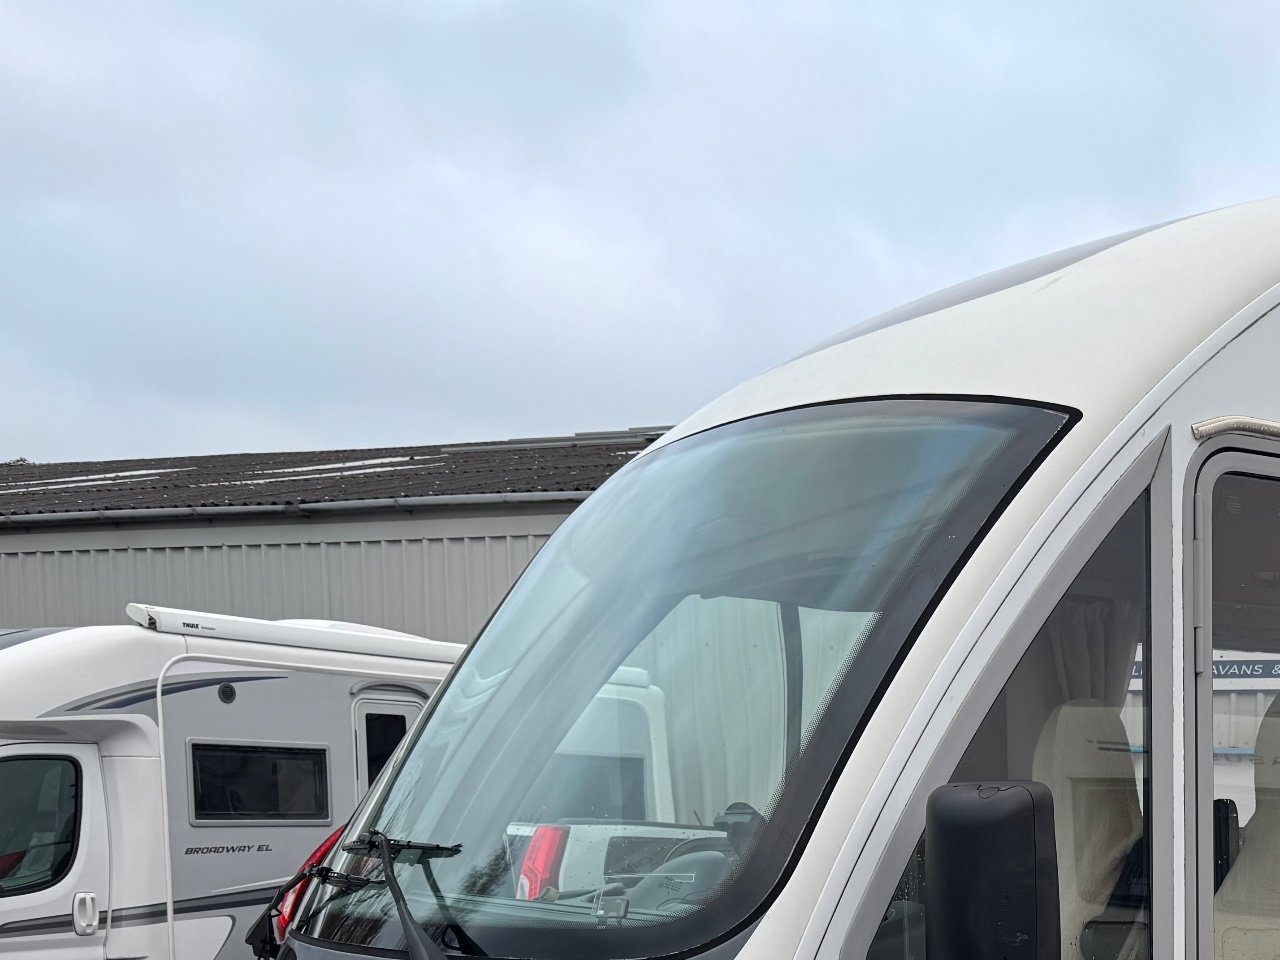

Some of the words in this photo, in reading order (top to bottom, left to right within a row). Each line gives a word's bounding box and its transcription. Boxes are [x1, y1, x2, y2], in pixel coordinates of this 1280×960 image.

[1272, 664, 1280, 675] &
[184, 844, 254, 855] BROADWAY
[256, 844, 273, 852] EL
